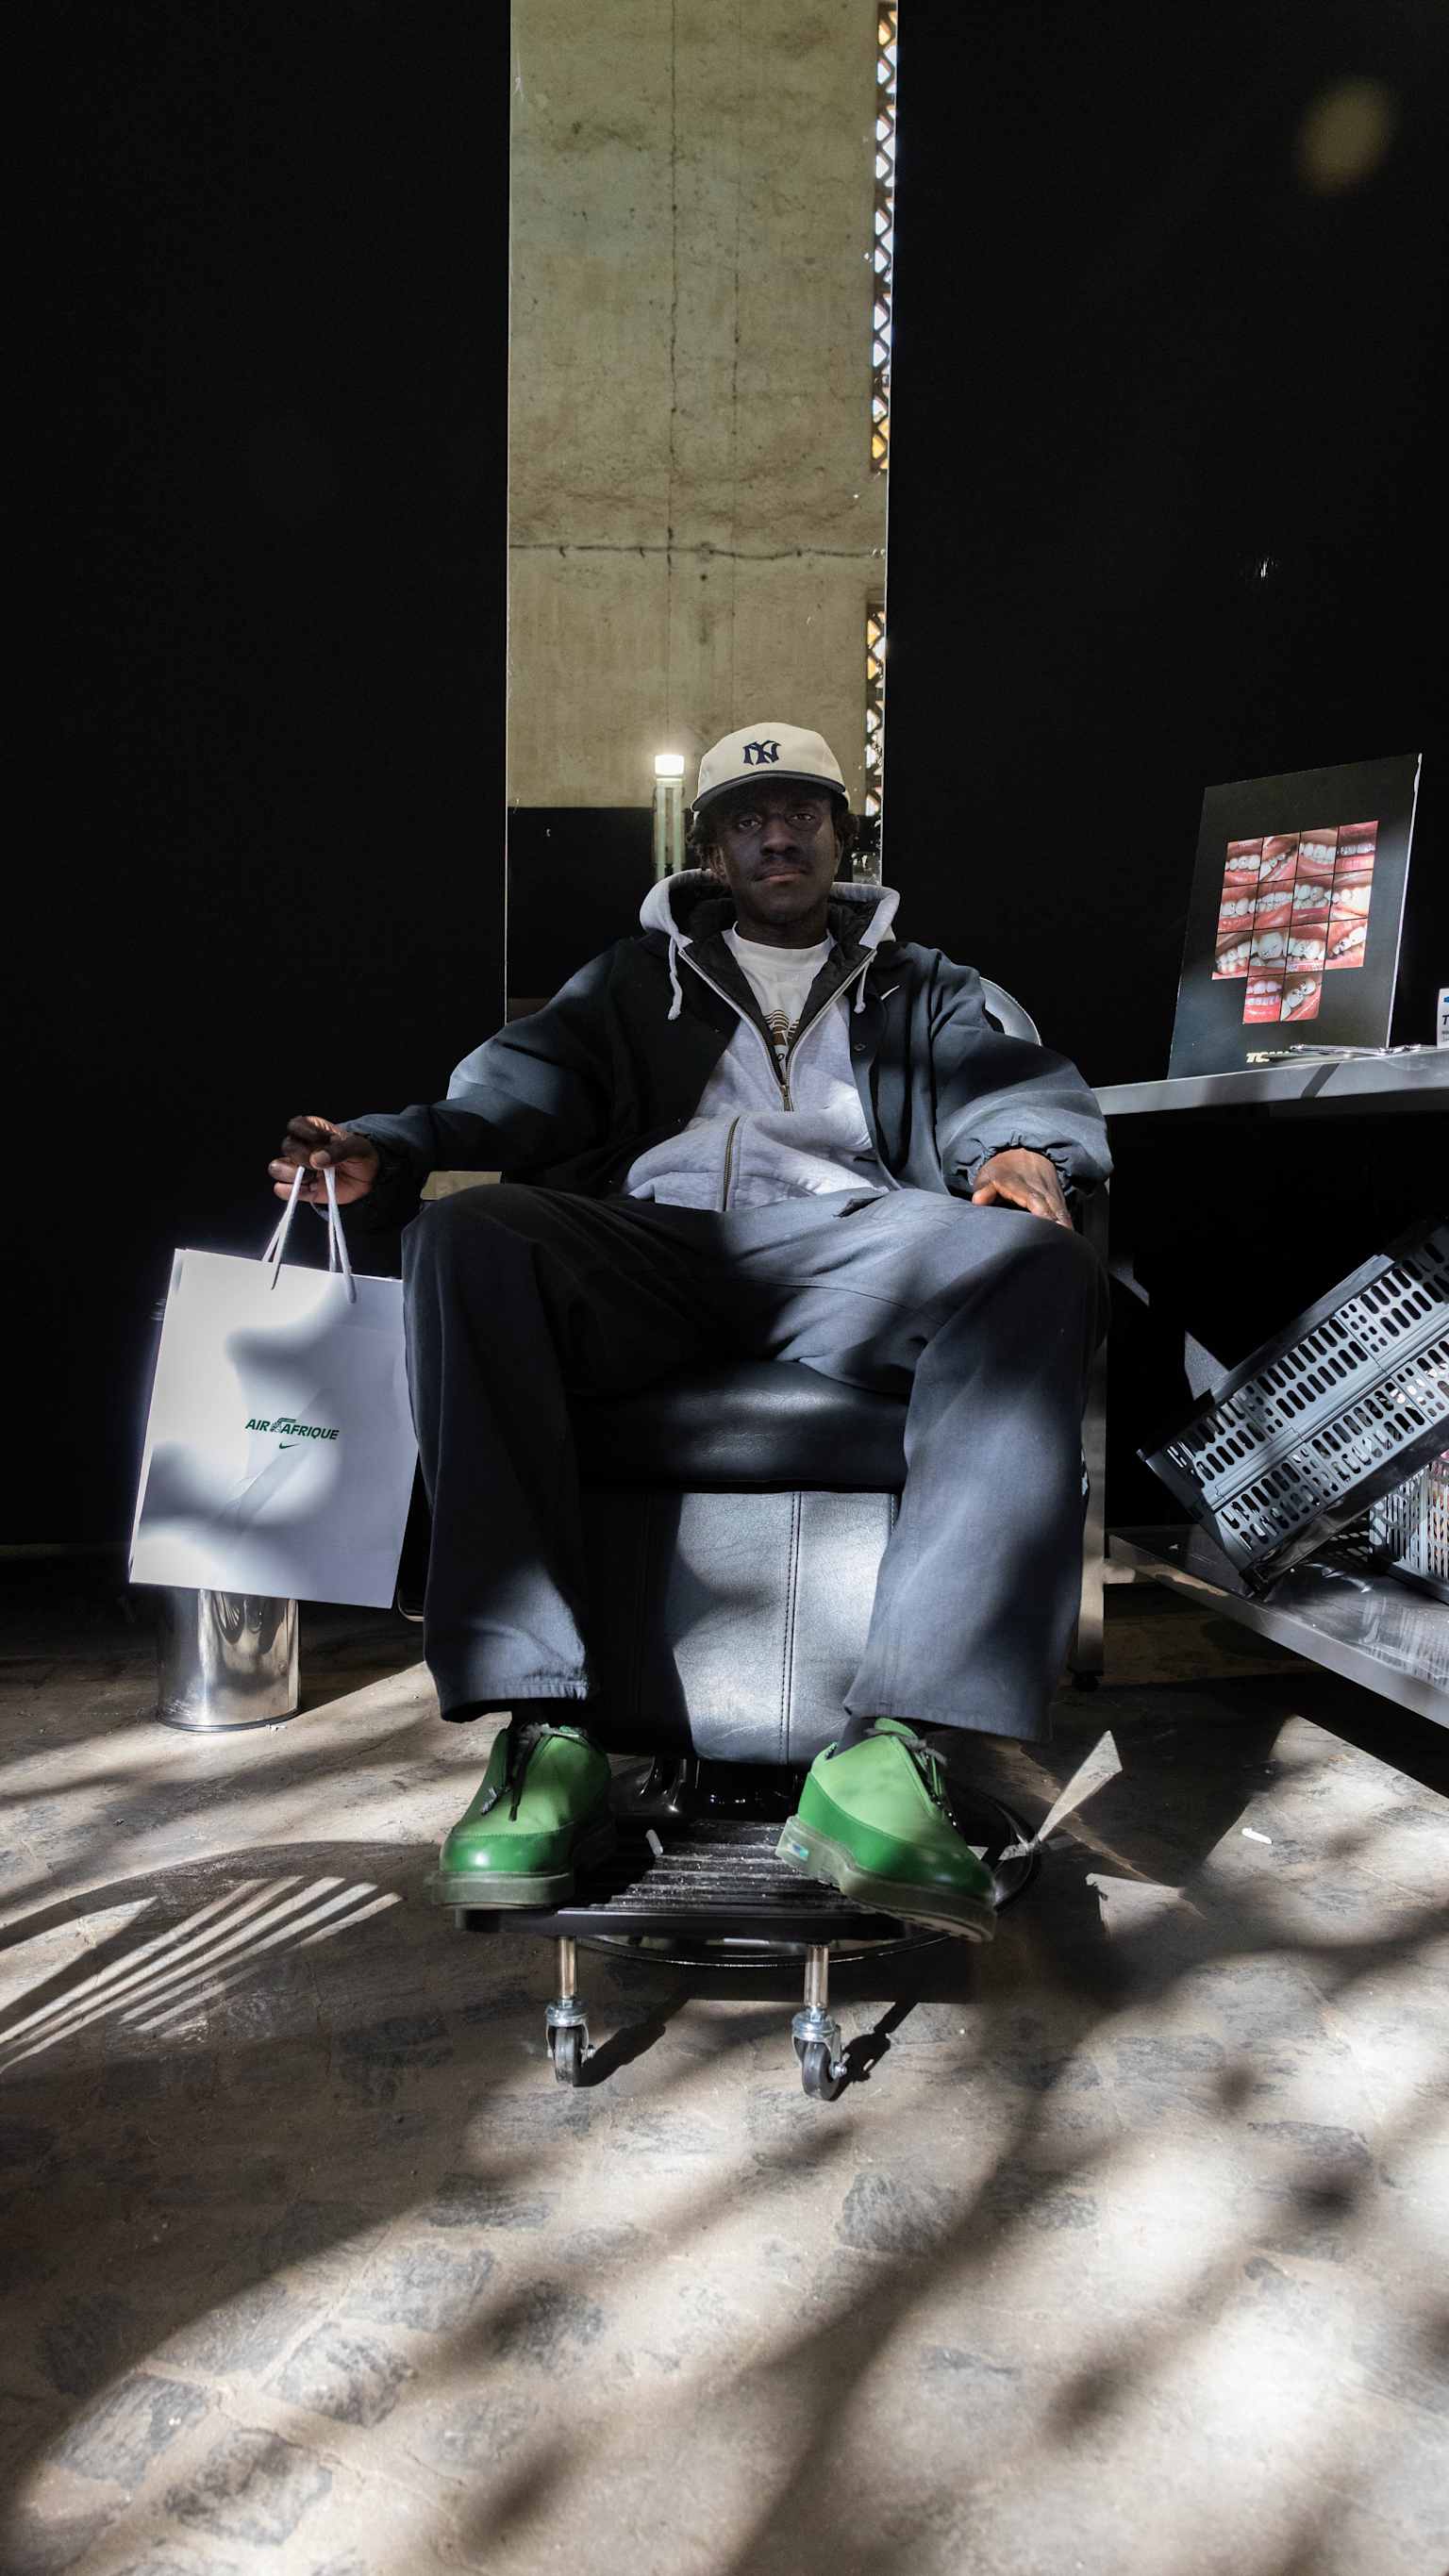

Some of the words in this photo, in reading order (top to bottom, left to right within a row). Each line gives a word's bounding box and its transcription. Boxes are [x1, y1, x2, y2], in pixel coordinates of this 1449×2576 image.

[742, 740, 782, 765] NY
[245, 1419, 271, 1431] AIR
[280, 1423, 340, 1439] AFRIQUE
